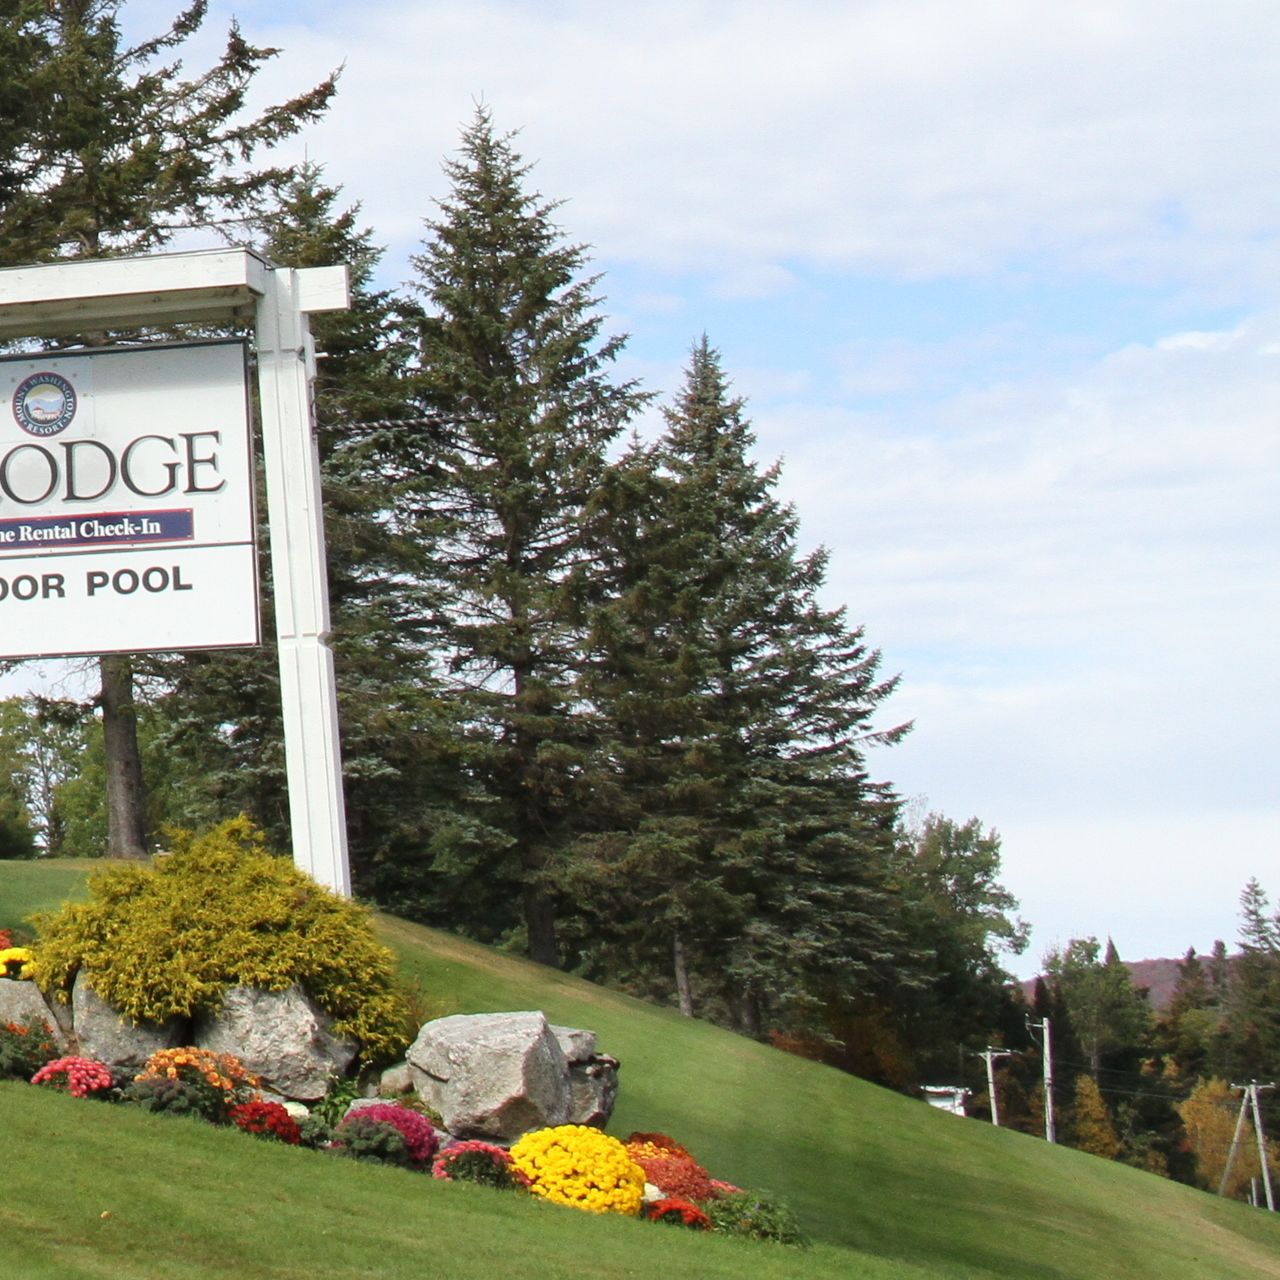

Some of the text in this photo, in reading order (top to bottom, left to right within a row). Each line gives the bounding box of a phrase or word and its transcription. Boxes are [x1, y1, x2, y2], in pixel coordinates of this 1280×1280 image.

[15, 375, 74, 422] MOUNT WASHINGTON
[26, 421, 64, 434] RESORT
[18, 521, 77, 542] Rental
[79, 519, 161, 538] Check-In
[86, 566, 193, 597] POOL
